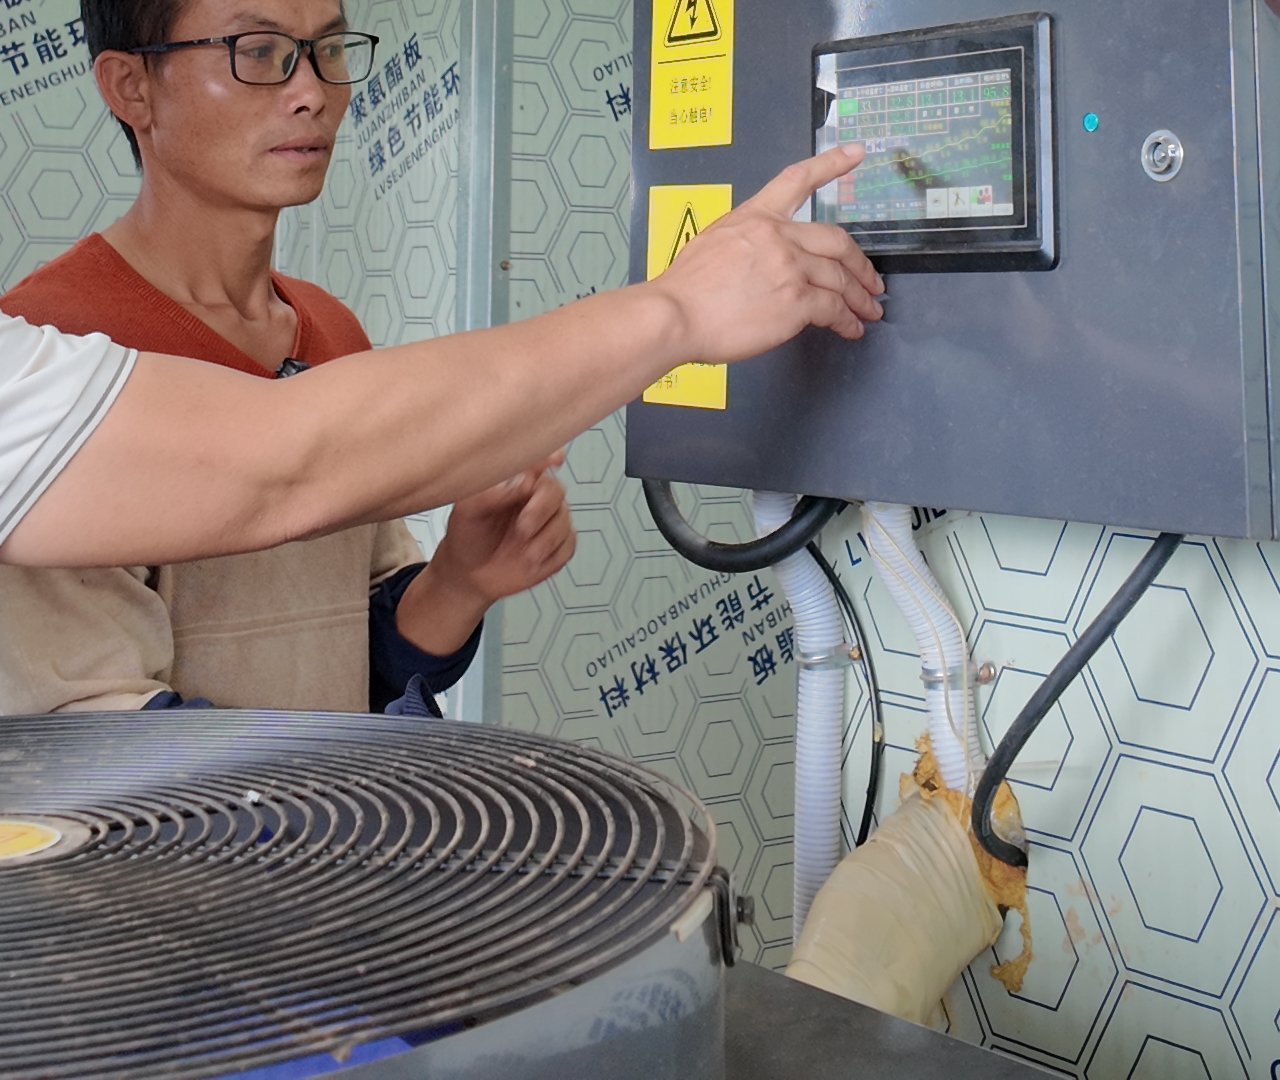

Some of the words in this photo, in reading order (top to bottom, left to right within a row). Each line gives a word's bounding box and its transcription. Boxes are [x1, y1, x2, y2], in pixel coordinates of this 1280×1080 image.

[350, 32, 423, 129] 聚氨酯板
[357, 69, 426, 150] JUANZHIBAN
[593, 51, 634, 82] ILIAO
[586, 573, 737, 678] GHUANBAOCAILIAO
